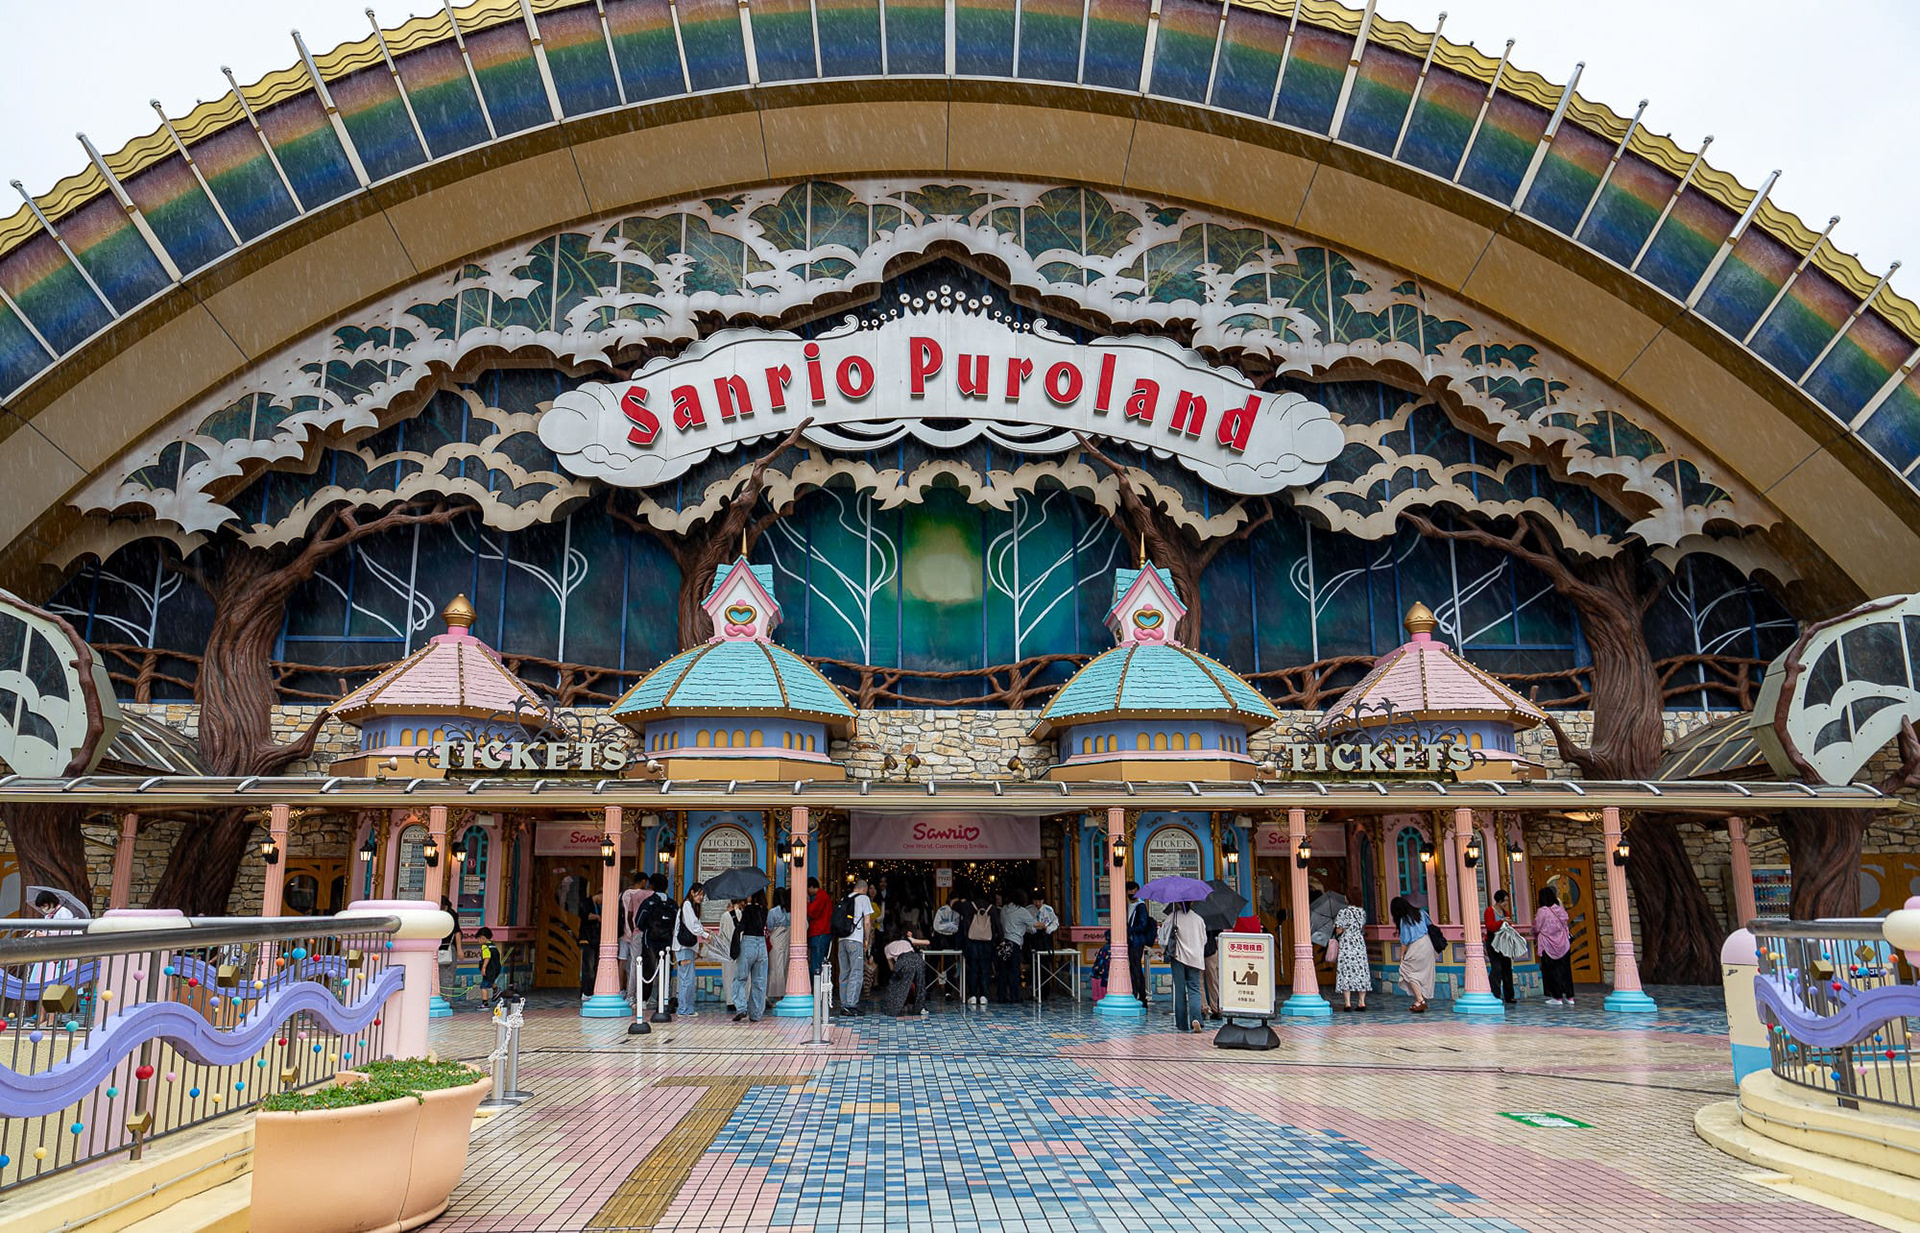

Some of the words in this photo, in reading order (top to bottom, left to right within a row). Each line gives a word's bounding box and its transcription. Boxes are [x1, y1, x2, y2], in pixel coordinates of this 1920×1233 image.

[620, 342, 876, 445] Sanrio
[909, 336, 1263, 453] Puroland
[432, 741, 628, 771] TICKETS
[1286, 743, 1472, 771] TICKETS
[708, 839, 746, 847] TICKETS
[1155, 840, 1192, 848] TICKETS
